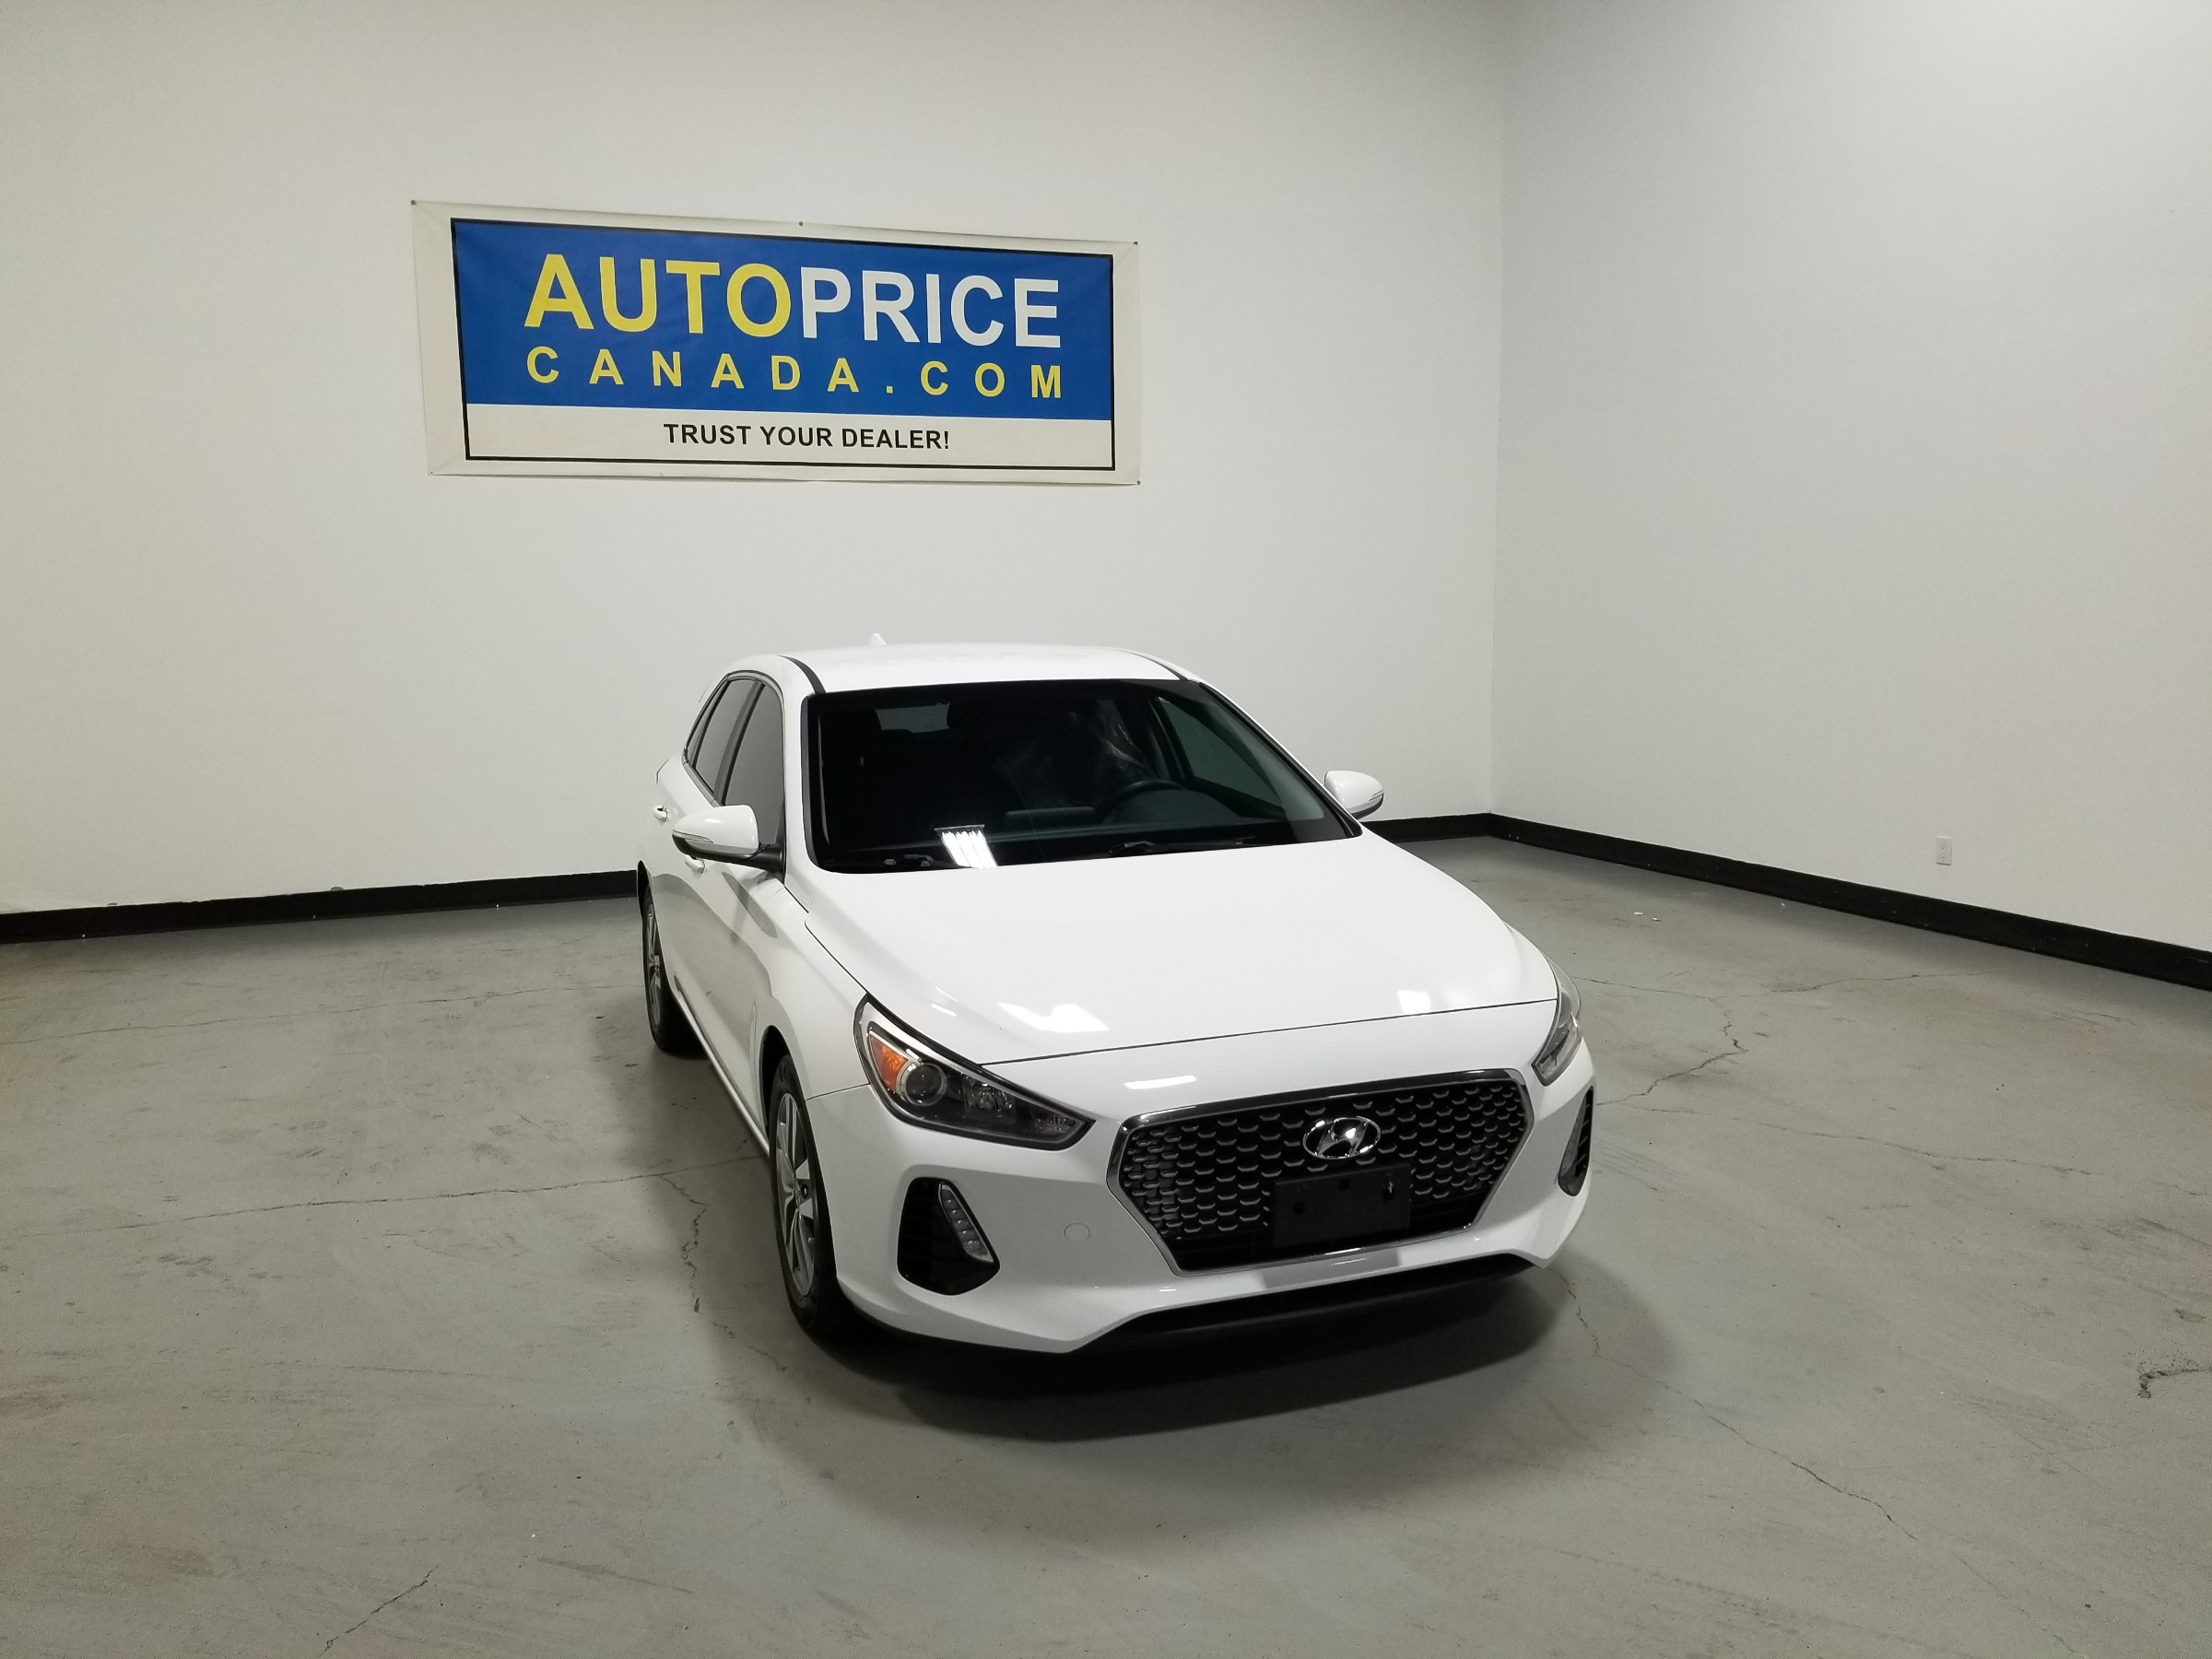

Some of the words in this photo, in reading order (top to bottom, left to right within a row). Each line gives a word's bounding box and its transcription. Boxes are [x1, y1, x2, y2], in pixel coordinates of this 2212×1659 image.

[524, 253, 1061, 348] AUTOPRICE
[526, 346, 1061, 399] CANADA.COM
[663, 423, 752, 445] TRUST
[759, 426, 833, 448] YOUR
[841, 428, 949, 450] DEALER!
